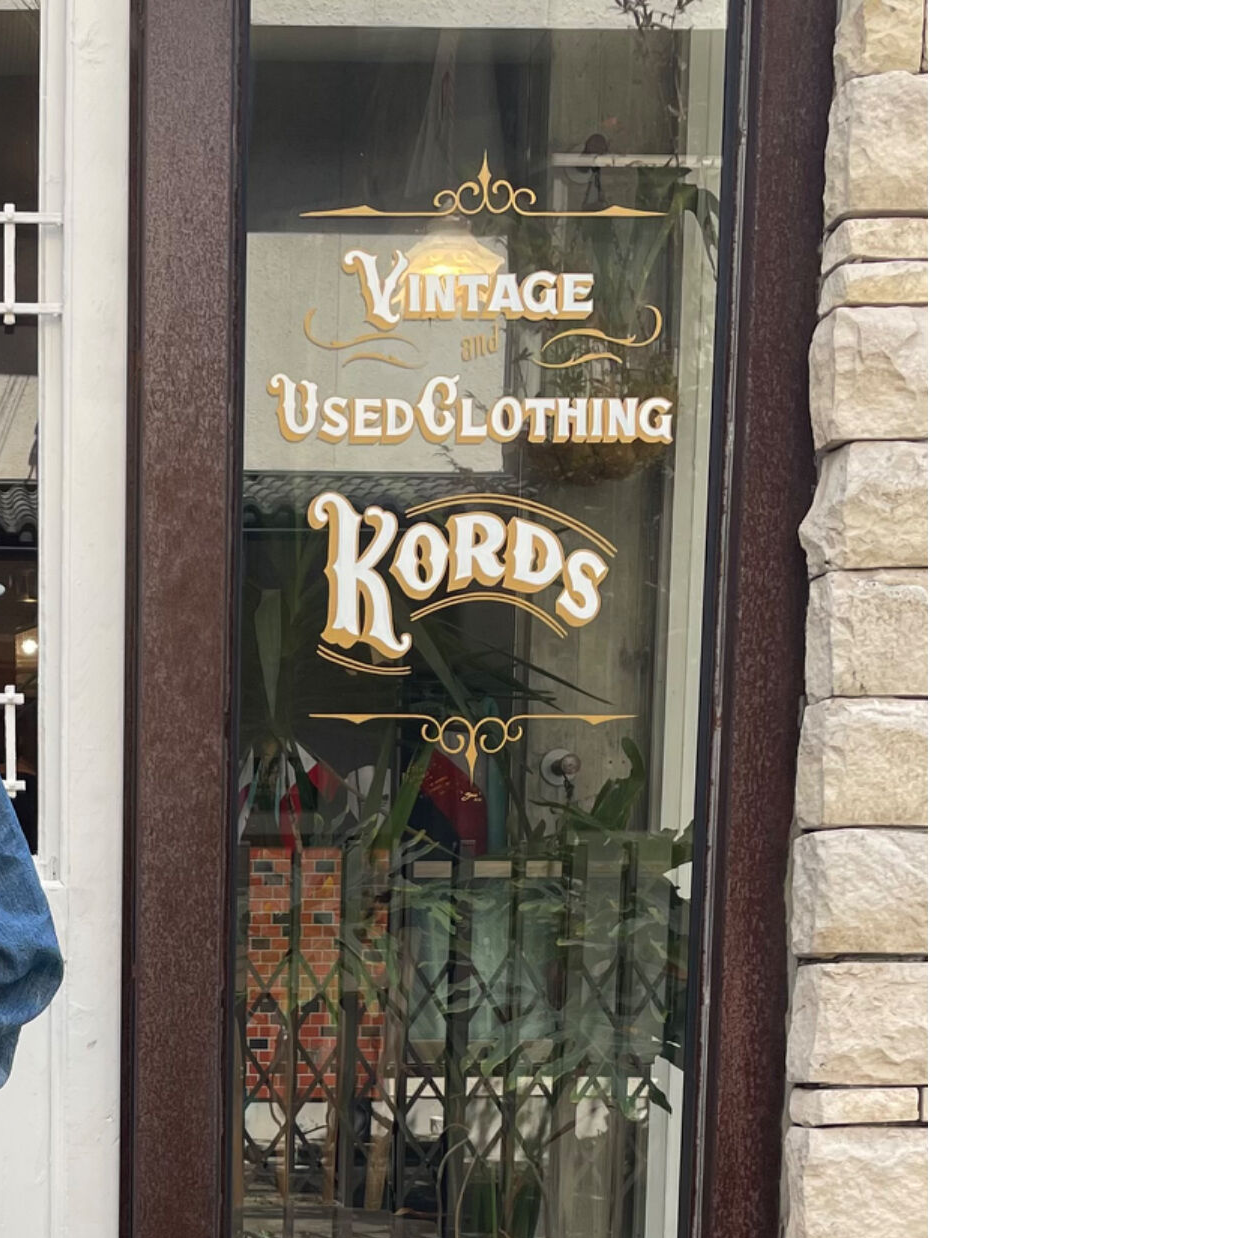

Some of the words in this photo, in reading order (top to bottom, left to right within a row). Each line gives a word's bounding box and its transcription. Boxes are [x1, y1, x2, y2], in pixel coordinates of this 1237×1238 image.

[342, 250, 594, 331] VINTAGE
[461, 324, 500, 362] and
[308, 491, 609, 659] KORDS
